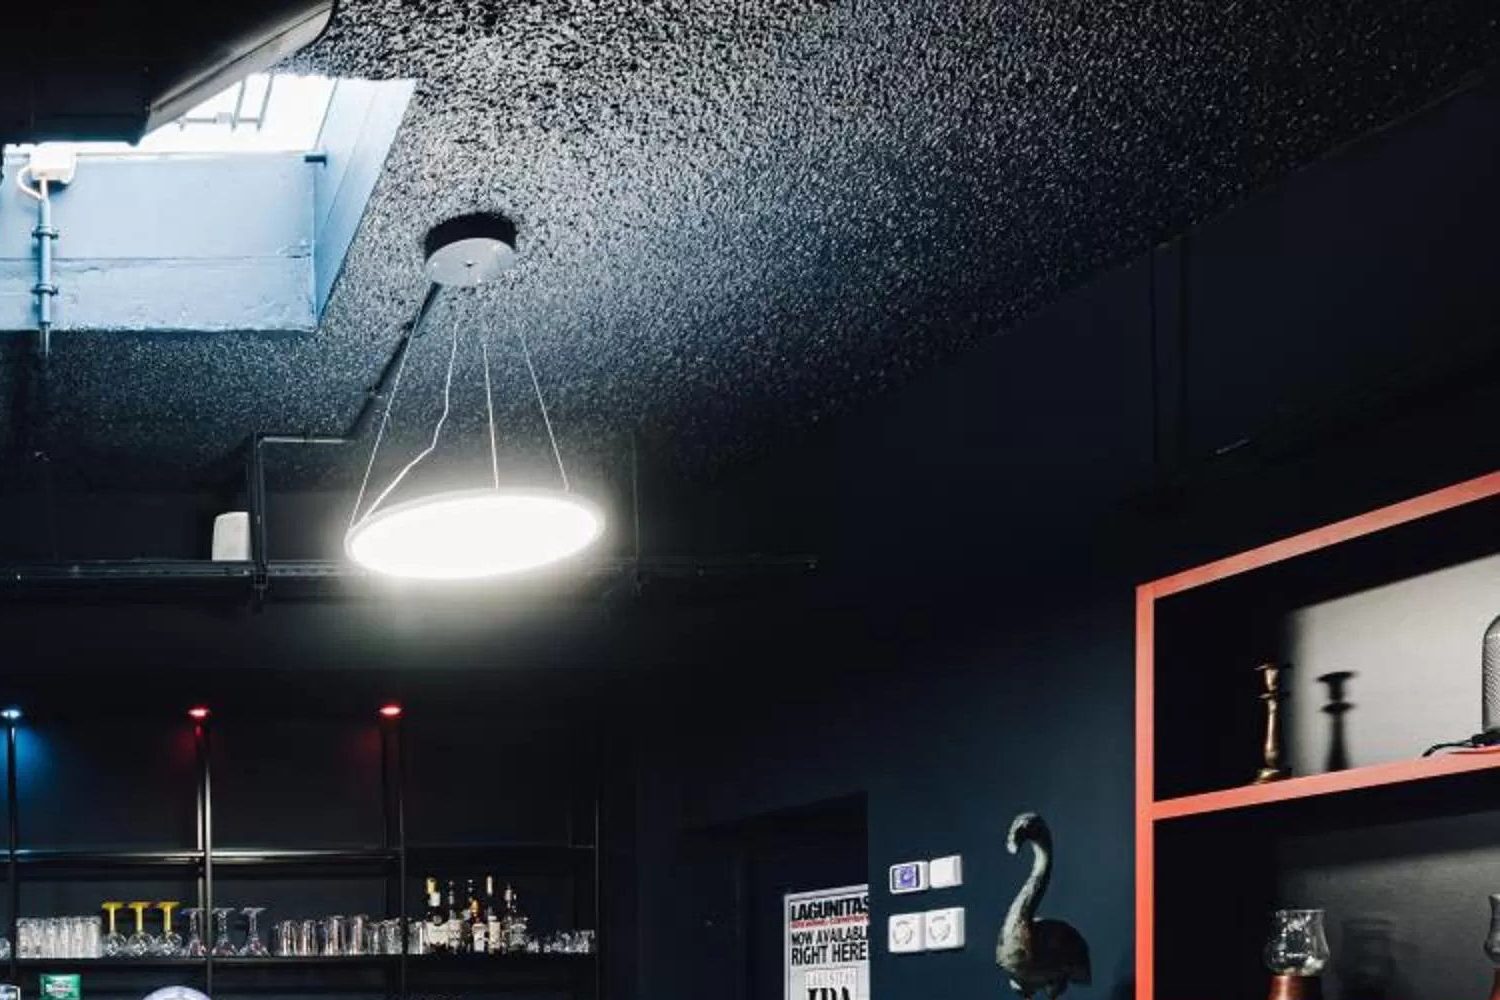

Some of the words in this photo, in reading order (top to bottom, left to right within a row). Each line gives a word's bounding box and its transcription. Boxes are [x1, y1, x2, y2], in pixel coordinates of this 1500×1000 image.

[791, 896, 868, 920] LAGUNITAS
[791, 931, 813, 946] NOW
[816, 925, 868, 945] AVAILABL
[791, 945, 828, 966] RIGHT
